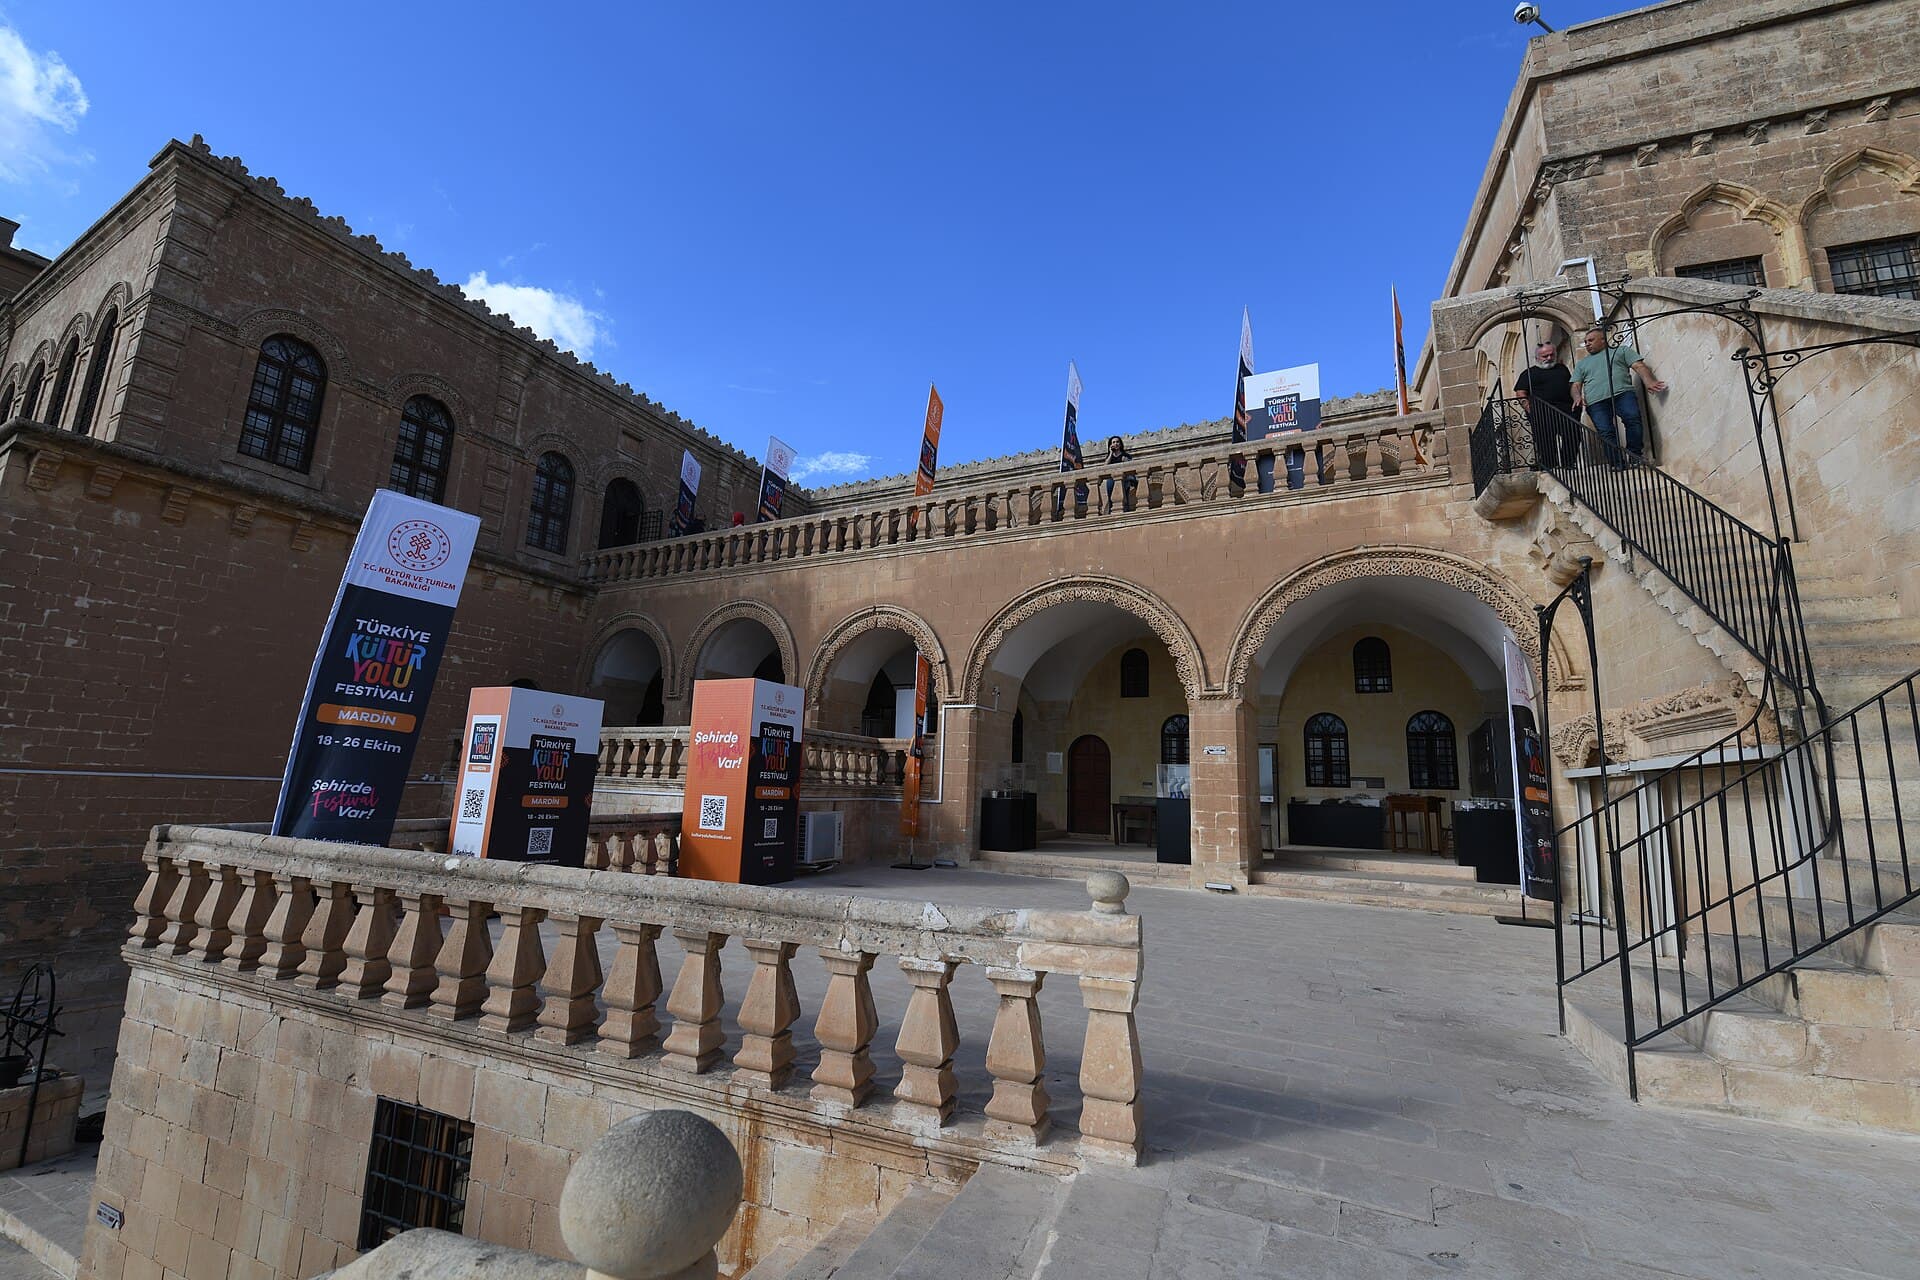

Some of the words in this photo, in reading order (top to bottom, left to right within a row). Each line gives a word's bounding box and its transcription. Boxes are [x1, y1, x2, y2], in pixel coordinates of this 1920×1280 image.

[1268, 395, 1296, 406] TÜRKİYE
[1268, 402, 1297, 417] KÜLTÜR
[1272, 409, 1294, 424] YOLU
[362, 562, 377, 572] T.C.
[378, 566, 411, 580] KÜLTÜR
[413, 575, 424, 583] VE
[425, 577, 456, 591] TURİZM
[385, 576, 430, 592] BAKANLIĞI
[356, 618, 431, 643] TÜRKİYE
[345, 632, 426, 670] KÜLTÜR
[353, 659, 414, 689] YOLU
[335, 682, 414, 703] FESTİVALİ
[338, 709, 397, 726] MARDİN
[474, 733, 494, 745] KÜLTÜR
[695, 731, 738, 745] Şehirde
[763, 726, 791, 739] TÜRKİYE
[317, 734, 332, 746] 18
[342, 736, 361, 748] 26
[363, 739, 401, 753] Ekim
[535, 738, 571, 751] TÜRKİYE
[762, 737, 790, 758] KÜLTÜR
[532, 750, 570, 768] KÜLTÜR
[718, 757, 743, 769] Var!
[765, 754, 787, 771] YOLU
[535, 764, 566, 781] YOLU
[760, 771, 788, 780] FESTİVALİ
[311, 779, 372, 795] Şehirde
[529, 780, 566, 790] FESTİVALİ
[762, 788, 784, 797] MARDİN
[310, 786, 379, 818] Festival
[531, 797, 560, 805] MARDİN
[338, 806, 376, 819] Var!
[1530, 808, 1539, 816] 18
